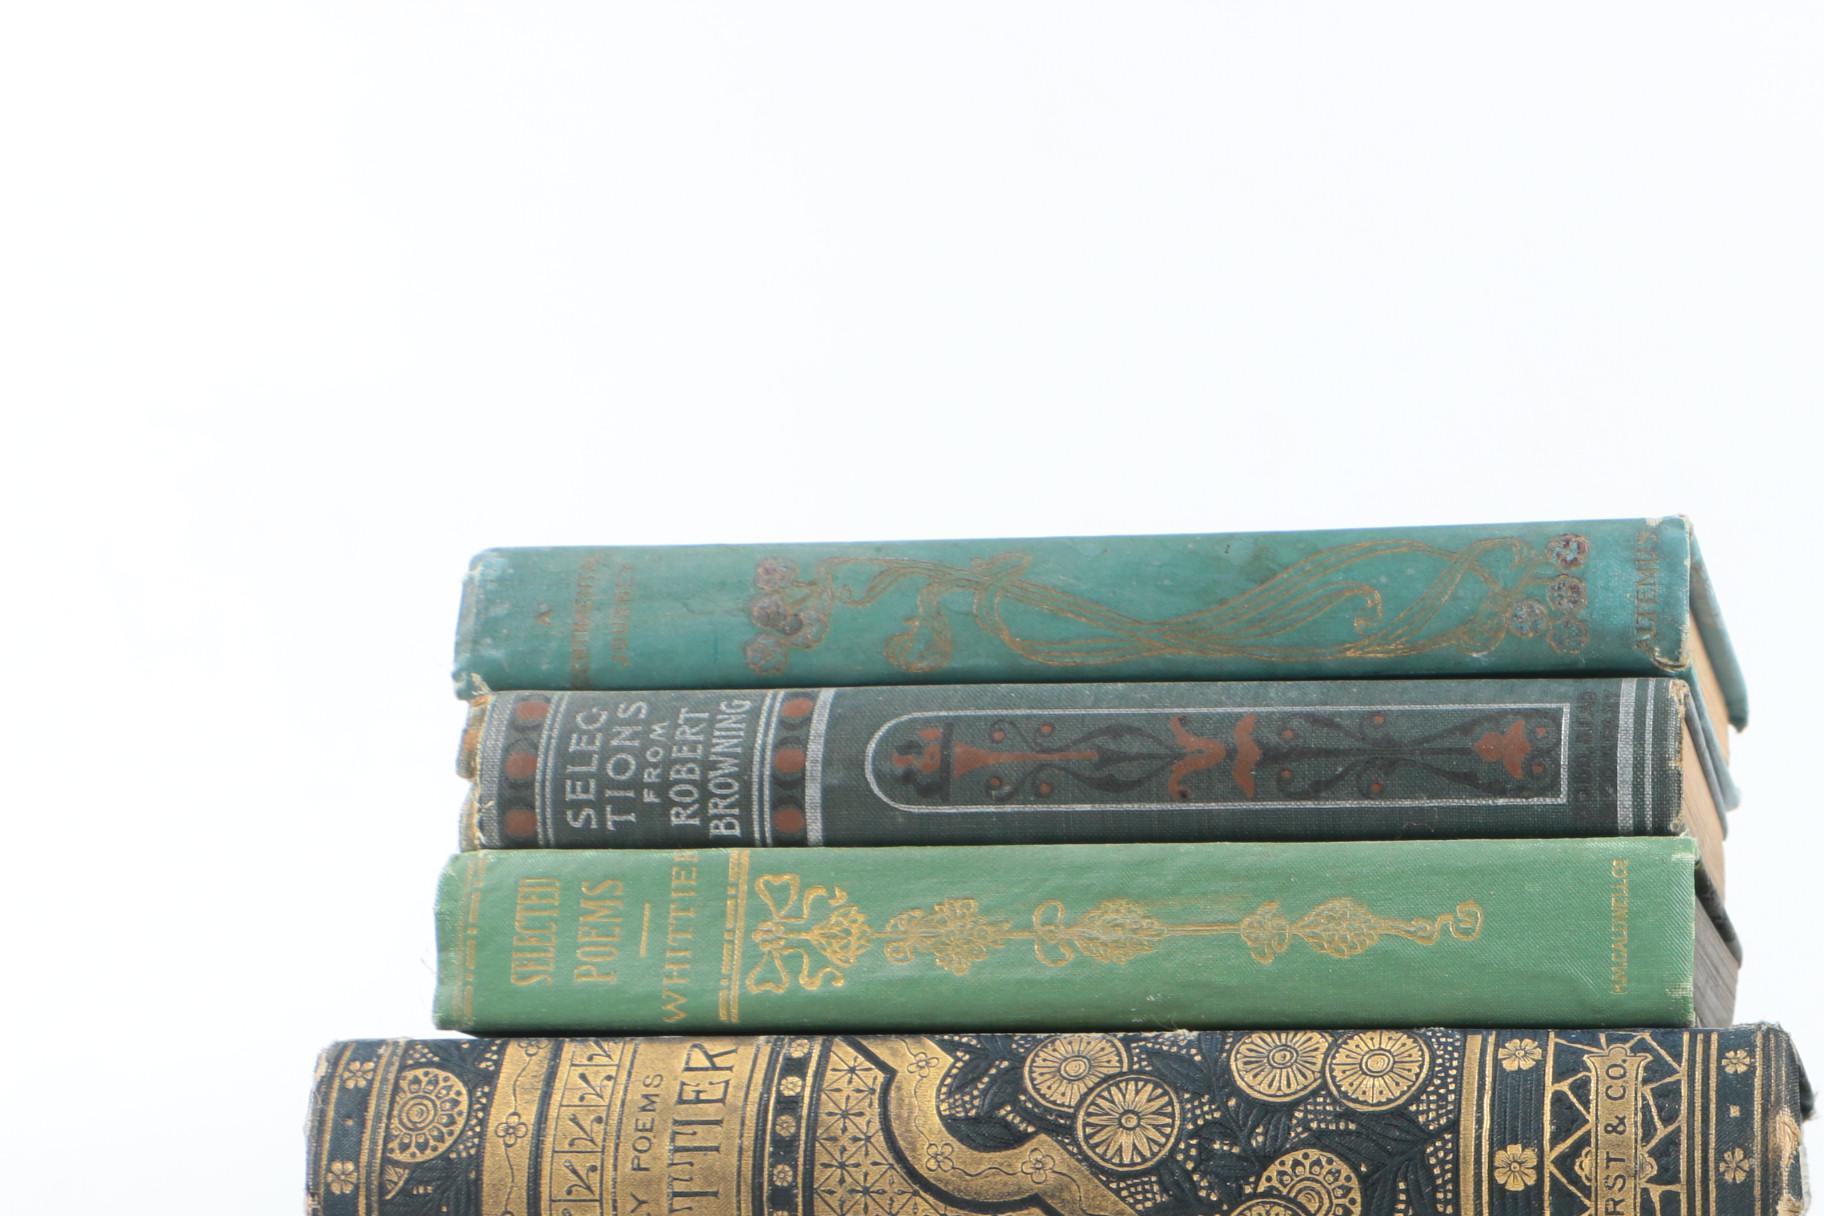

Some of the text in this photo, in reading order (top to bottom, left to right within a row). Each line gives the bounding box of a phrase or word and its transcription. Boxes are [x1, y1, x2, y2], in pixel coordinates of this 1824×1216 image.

[1633, 530, 1660, 655] ALTEMUS
[606, 700, 648, 830] TIONS
[643, 721, 668, 802] FROM
[670, 708, 710, 827] ROBERT
[709, 700, 752, 838] BROWNING
[511, 878, 560, 986] SELECTED
[575, 878, 624, 984] POEMS
[661, 850, 698, 1023] WHITTIER
[630, 1072, 664, 1173] POEMS
[1603, 1118, 1627, 1135] &
[1604, 1057, 1627, 1103] CO.
